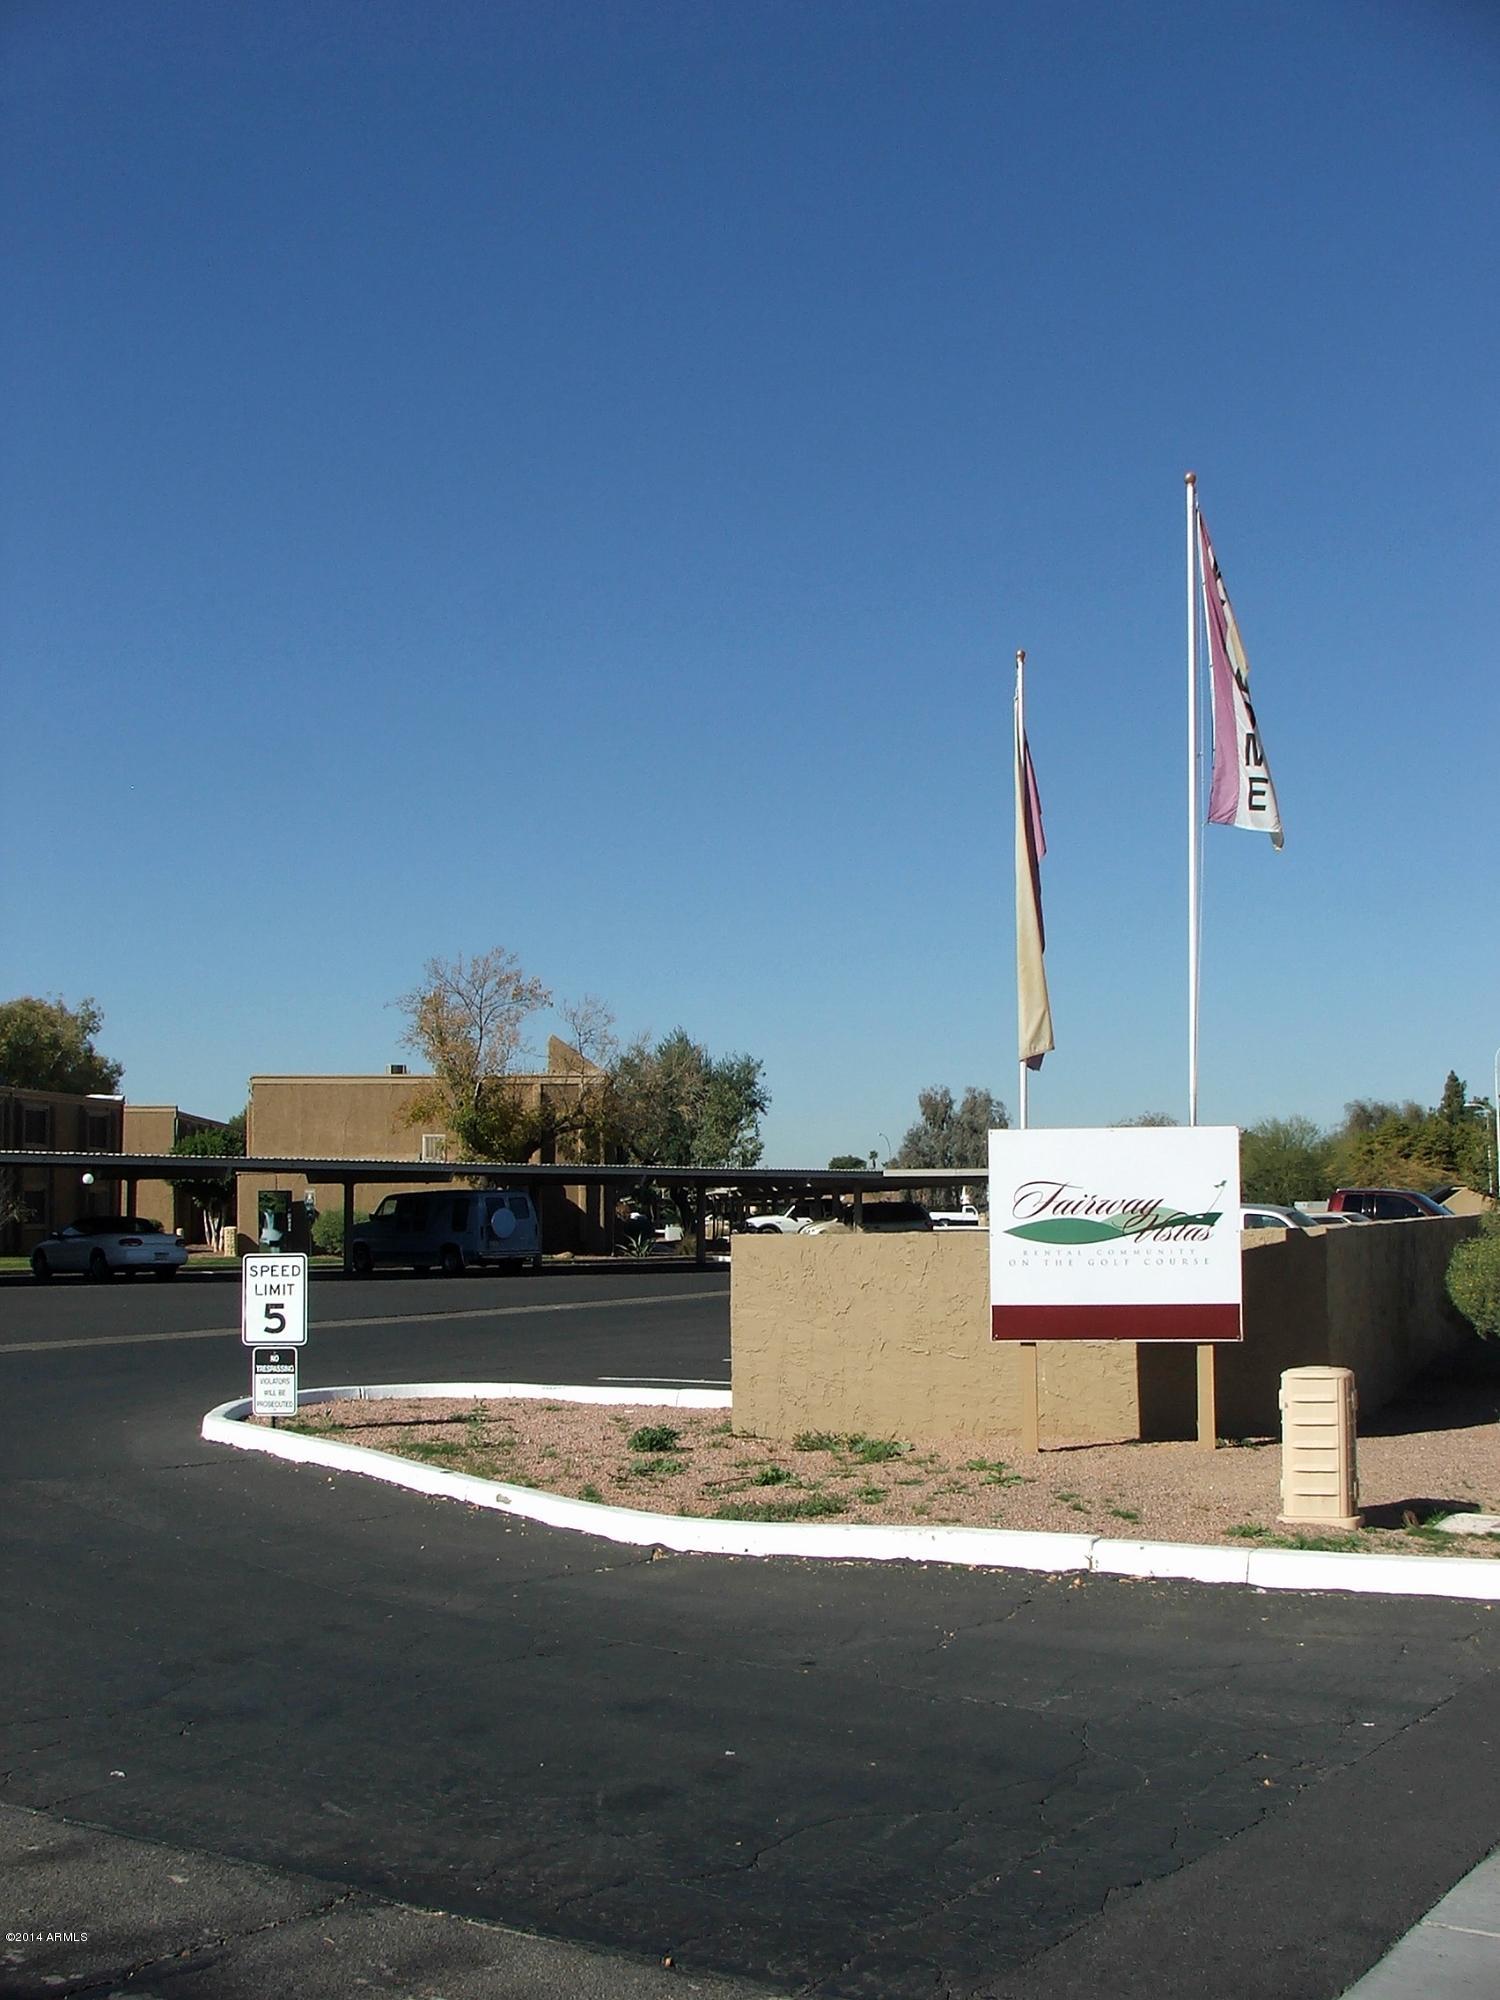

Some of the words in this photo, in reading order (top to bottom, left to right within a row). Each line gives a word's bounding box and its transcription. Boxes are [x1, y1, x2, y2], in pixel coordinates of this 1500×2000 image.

[1012, 1180, 1164, 1219] Fairway
[1111, 1211, 1215, 1244] Vistas
[1096, 1248, 1196, 1256] COMMUNITY
[1008, 1259, 1030, 1267] ON
[1044, 1258, 1074, 1267] THE
[1088, 1258, 1129, 1267] GOLF
[1143, 1257, 1210, 1266] COURSE
[249, 1265, 301, 1277] SPEED
[255, 1283, 295, 1296] LIMIT
[264, 1303, 286, 1334] 5
